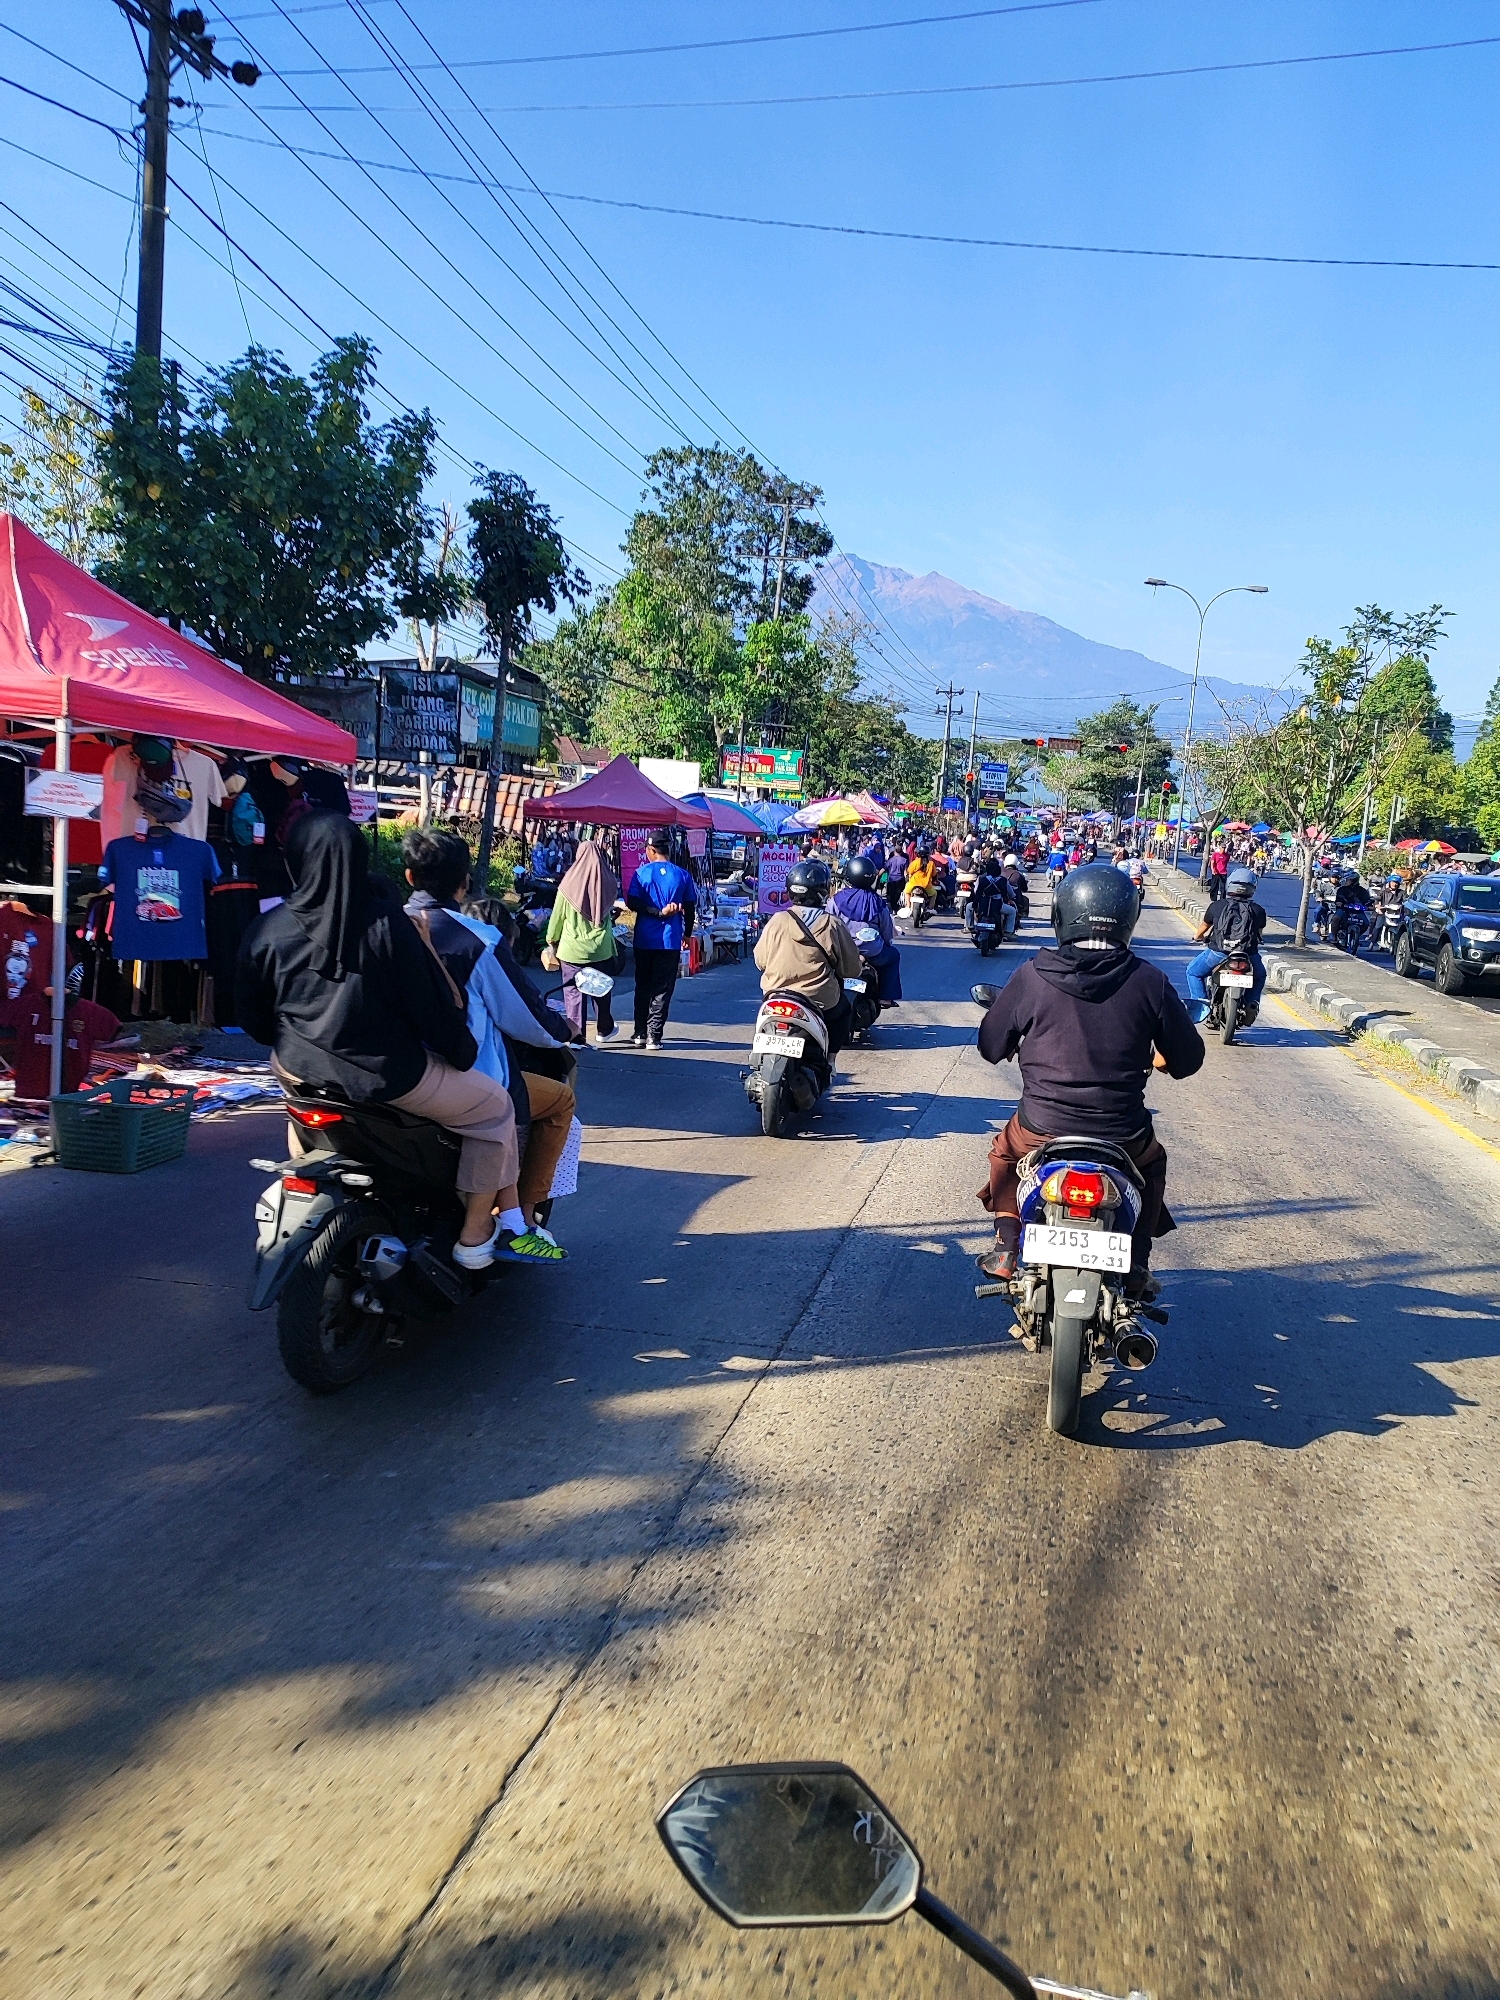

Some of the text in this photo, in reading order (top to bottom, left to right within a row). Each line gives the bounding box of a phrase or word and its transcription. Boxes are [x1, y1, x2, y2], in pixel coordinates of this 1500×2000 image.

[79, 641, 189, 673] speeds
[413, 676, 432, 692] ISI
[402, 694, 444, 713] ULANG
[397, 714, 451, 732] PARFUM
[404, 733, 447, 750] BADAN
[762, 851, 796, 862] MOCHI
[1088, 915, 1118, 924] HONDA
[1026, 1227, 1128, 1253] H 2153 CL
